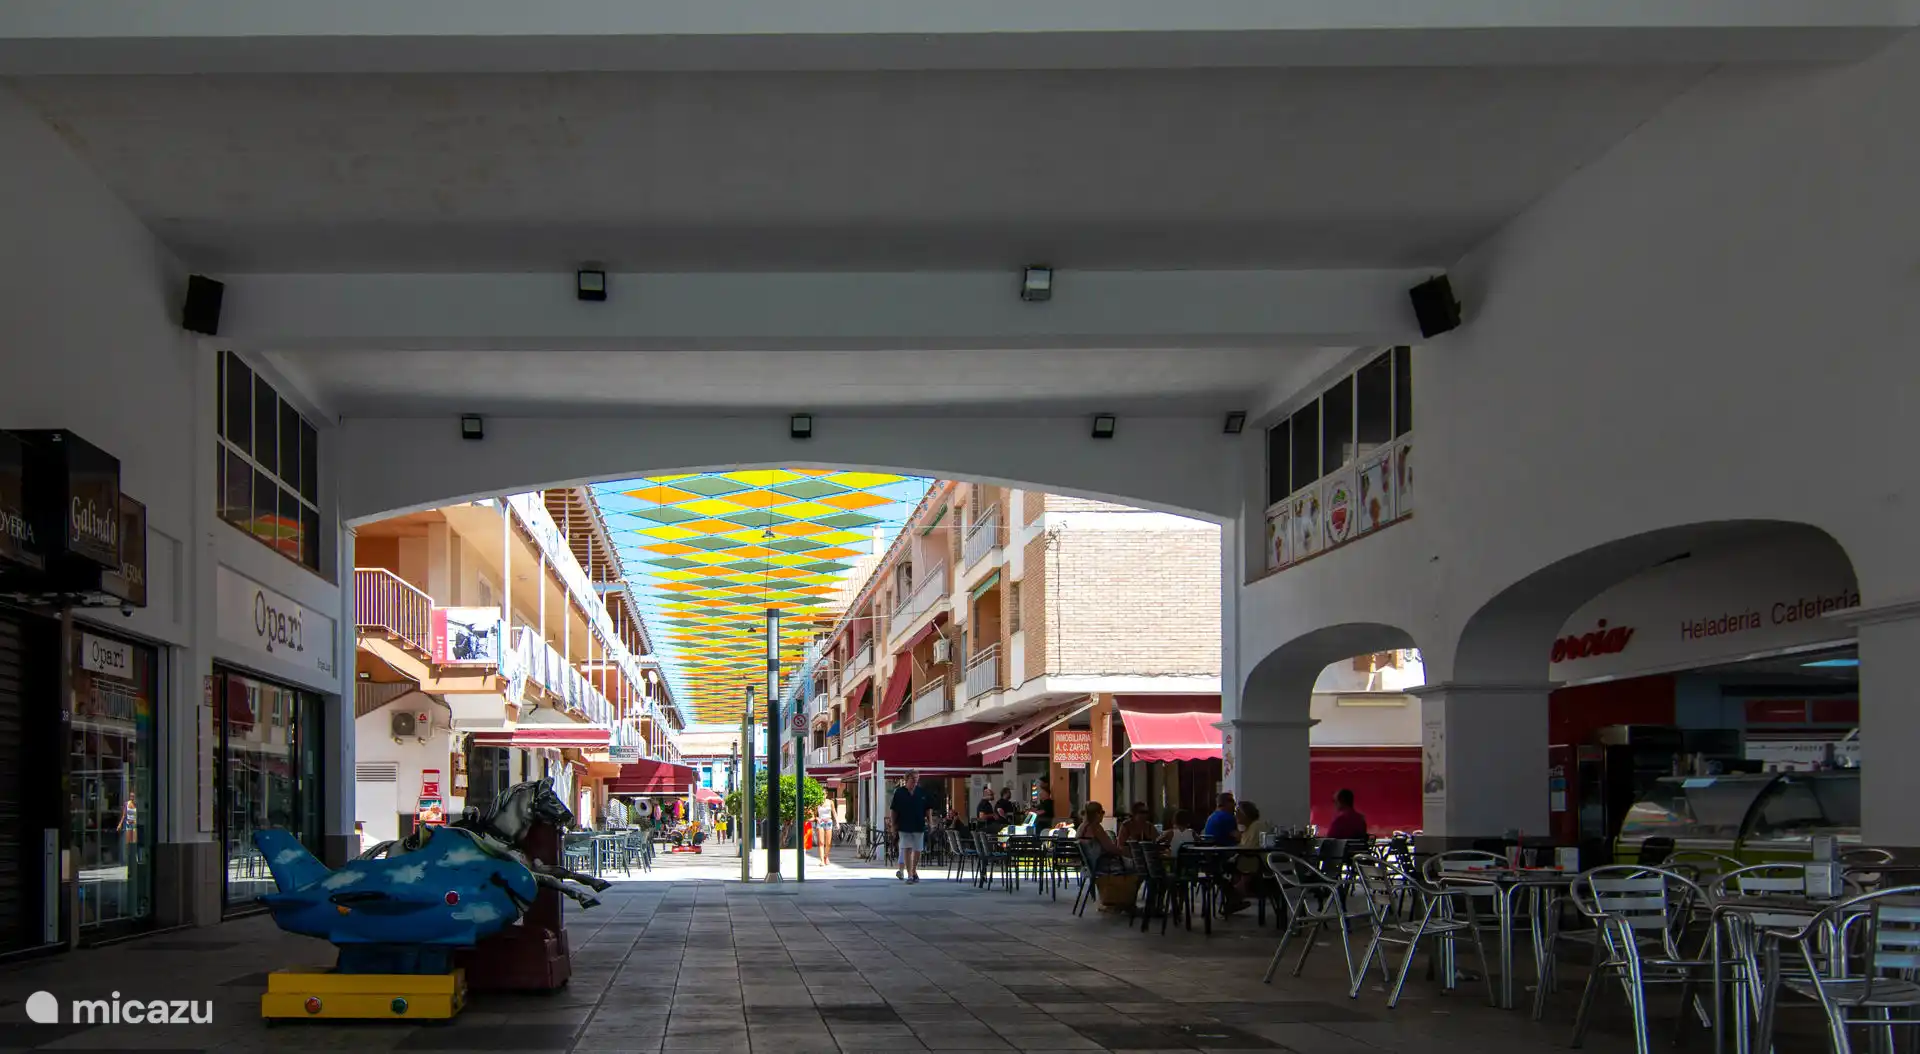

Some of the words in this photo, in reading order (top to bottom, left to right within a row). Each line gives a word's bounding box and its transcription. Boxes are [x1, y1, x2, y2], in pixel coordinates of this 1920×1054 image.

[72, 496, 116, 545] Galindo
[255, 590, 303, 653] Opari
[1681, 606, 1761, 641] Heladería
[93, 640, 124, 669] Opari
[1055, 733, 1091, 742] INMOBILIARIA
[1070, 743, 1090, 751] ZAPATA
